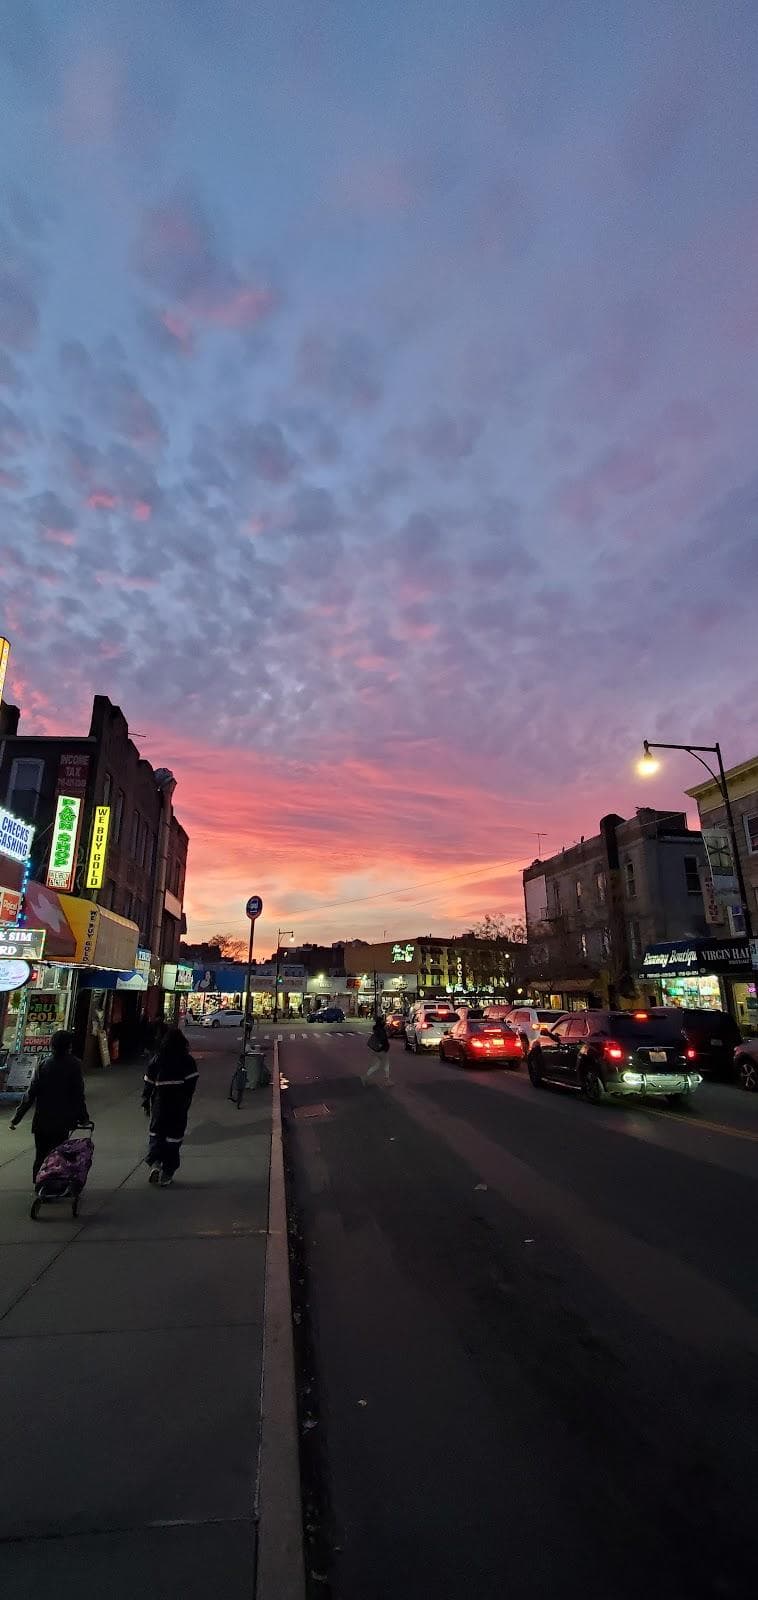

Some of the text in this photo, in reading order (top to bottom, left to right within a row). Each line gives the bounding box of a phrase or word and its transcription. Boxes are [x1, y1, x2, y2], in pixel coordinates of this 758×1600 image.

[58, 798, 76, 831] PAWN
[1, 816, 30, 843] CHECKS
[54, 832, 71, 867] SHOP
[90, 809, 107, 886] WE BUY GOLD
[8, 932, 33, 942] SIM
[82, 940, 91, 962] GOLD
[701, 947, 752, 961] VIRGIN HAI
[23, 1045, 53, 1053] REPAI
[24, 1038, 52, 1046] COMPUT
